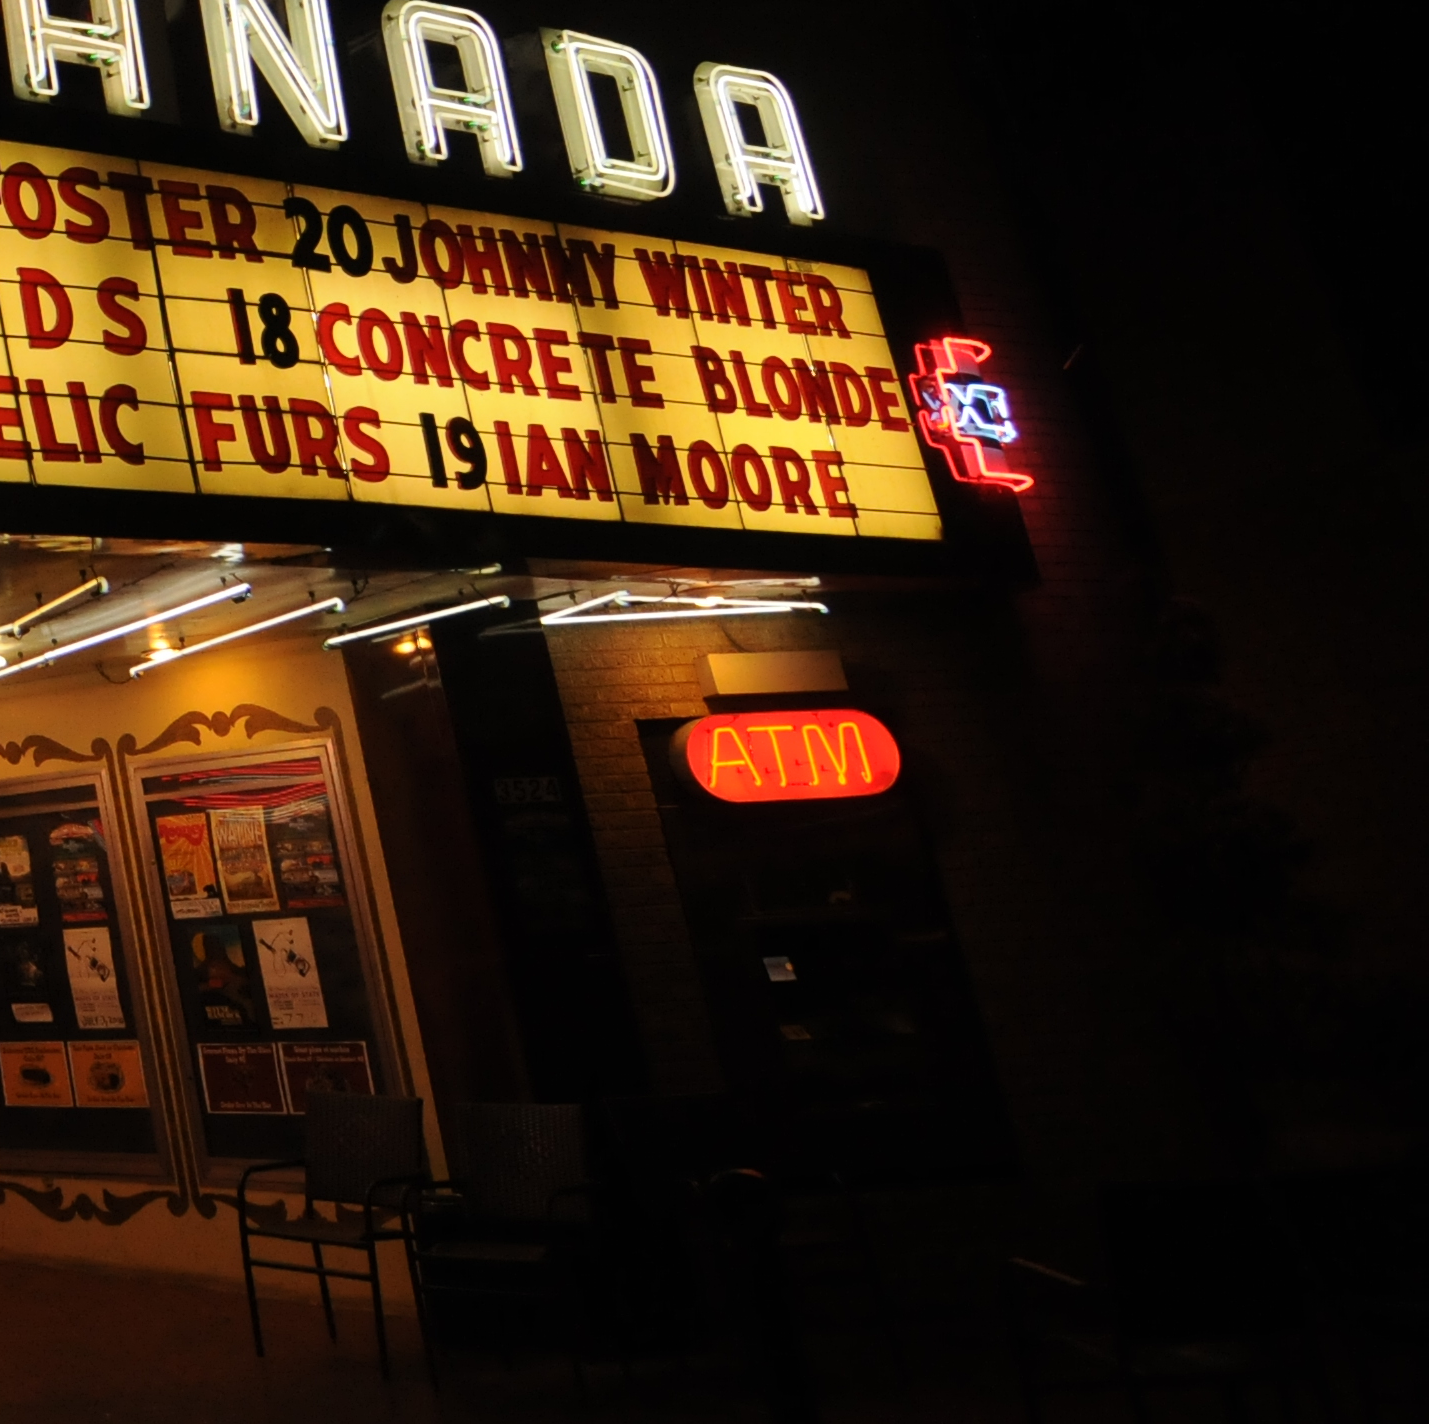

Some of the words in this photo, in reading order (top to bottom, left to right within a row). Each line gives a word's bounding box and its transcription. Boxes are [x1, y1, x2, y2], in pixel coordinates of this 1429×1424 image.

[282, 195, 373, 278] 20
[383, 213, 617, 310] JOHNNY
[633, 247, 852, 339] WINTER
[226, 287, 301, 368] 18
[315, 302, 665, 410] CONCRETE
[689, 345, 911, 432] BLONDE
[190, 390, 392, 482] FURS
[419, 412, 488, 490] 19
[493, 420, 614, 503] IAN
[630, 432, 858, 519] MOORE
[708, 721, 872, 788] ATM
